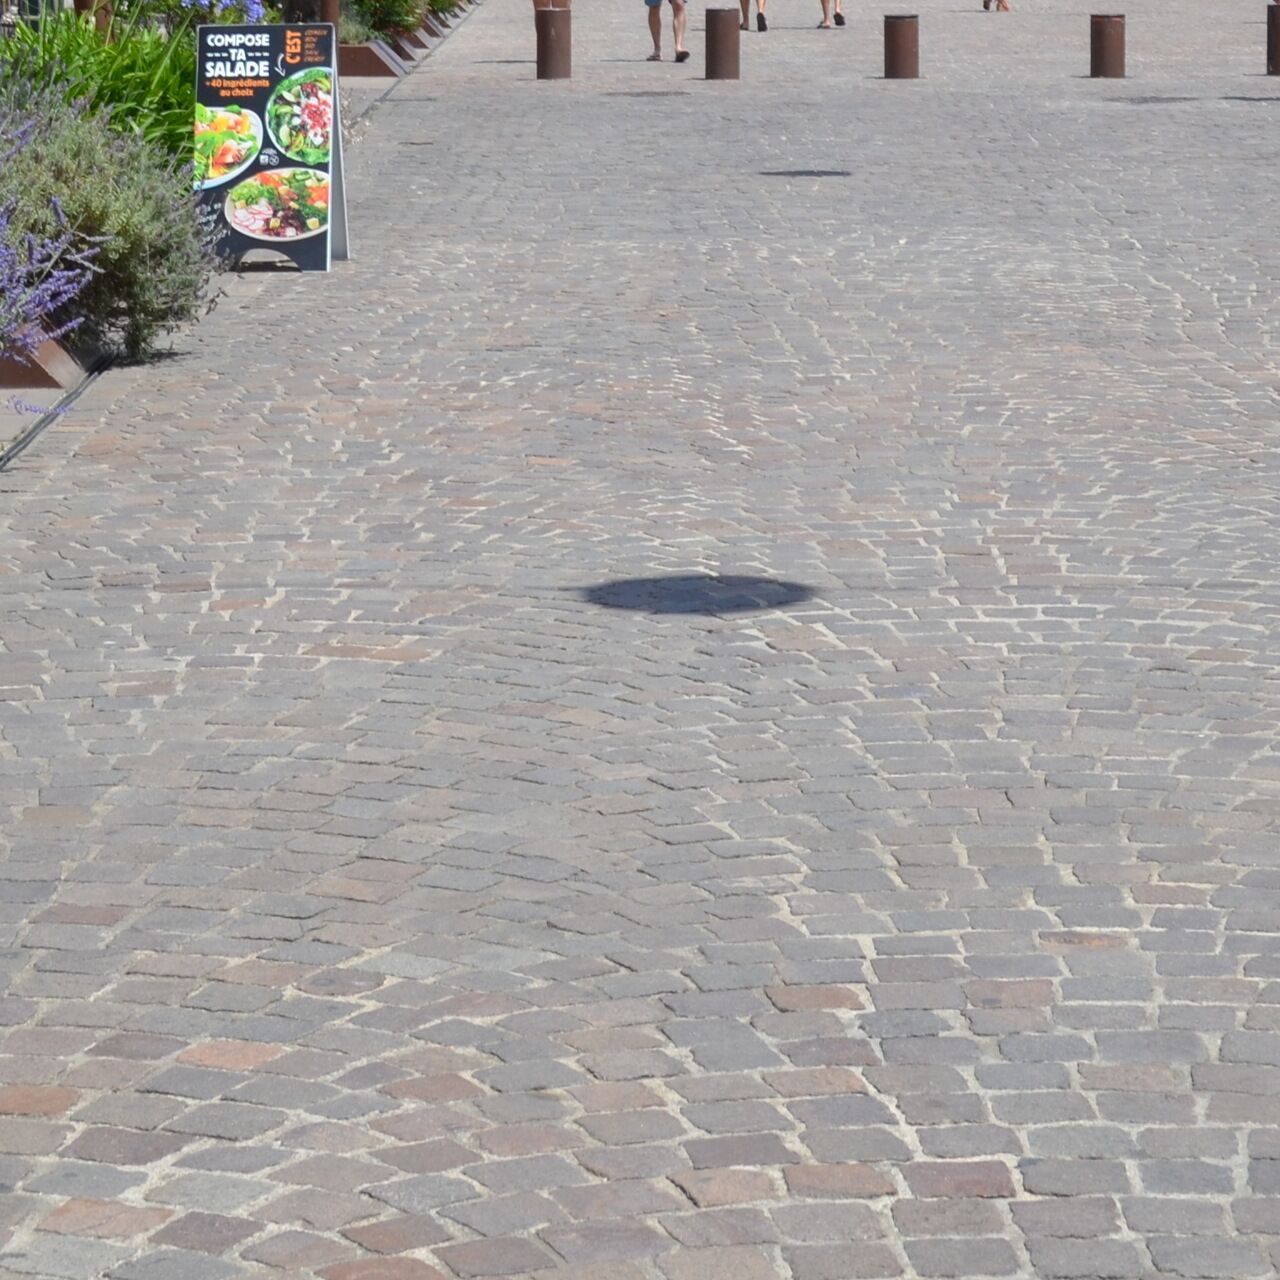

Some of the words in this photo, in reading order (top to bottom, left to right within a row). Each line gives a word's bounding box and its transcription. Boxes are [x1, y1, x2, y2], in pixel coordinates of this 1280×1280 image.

[206, 33, 270, 47] COMPOSE
[286, 30, 302, 64] C'EST
[228, 48, 247, 61] TA
[205, 61, 270, 78] SALADE
[223, 79, 270, 89] ingrédients
[219, 89, 231, 97] au
[232, 88, 254, 97] choix
